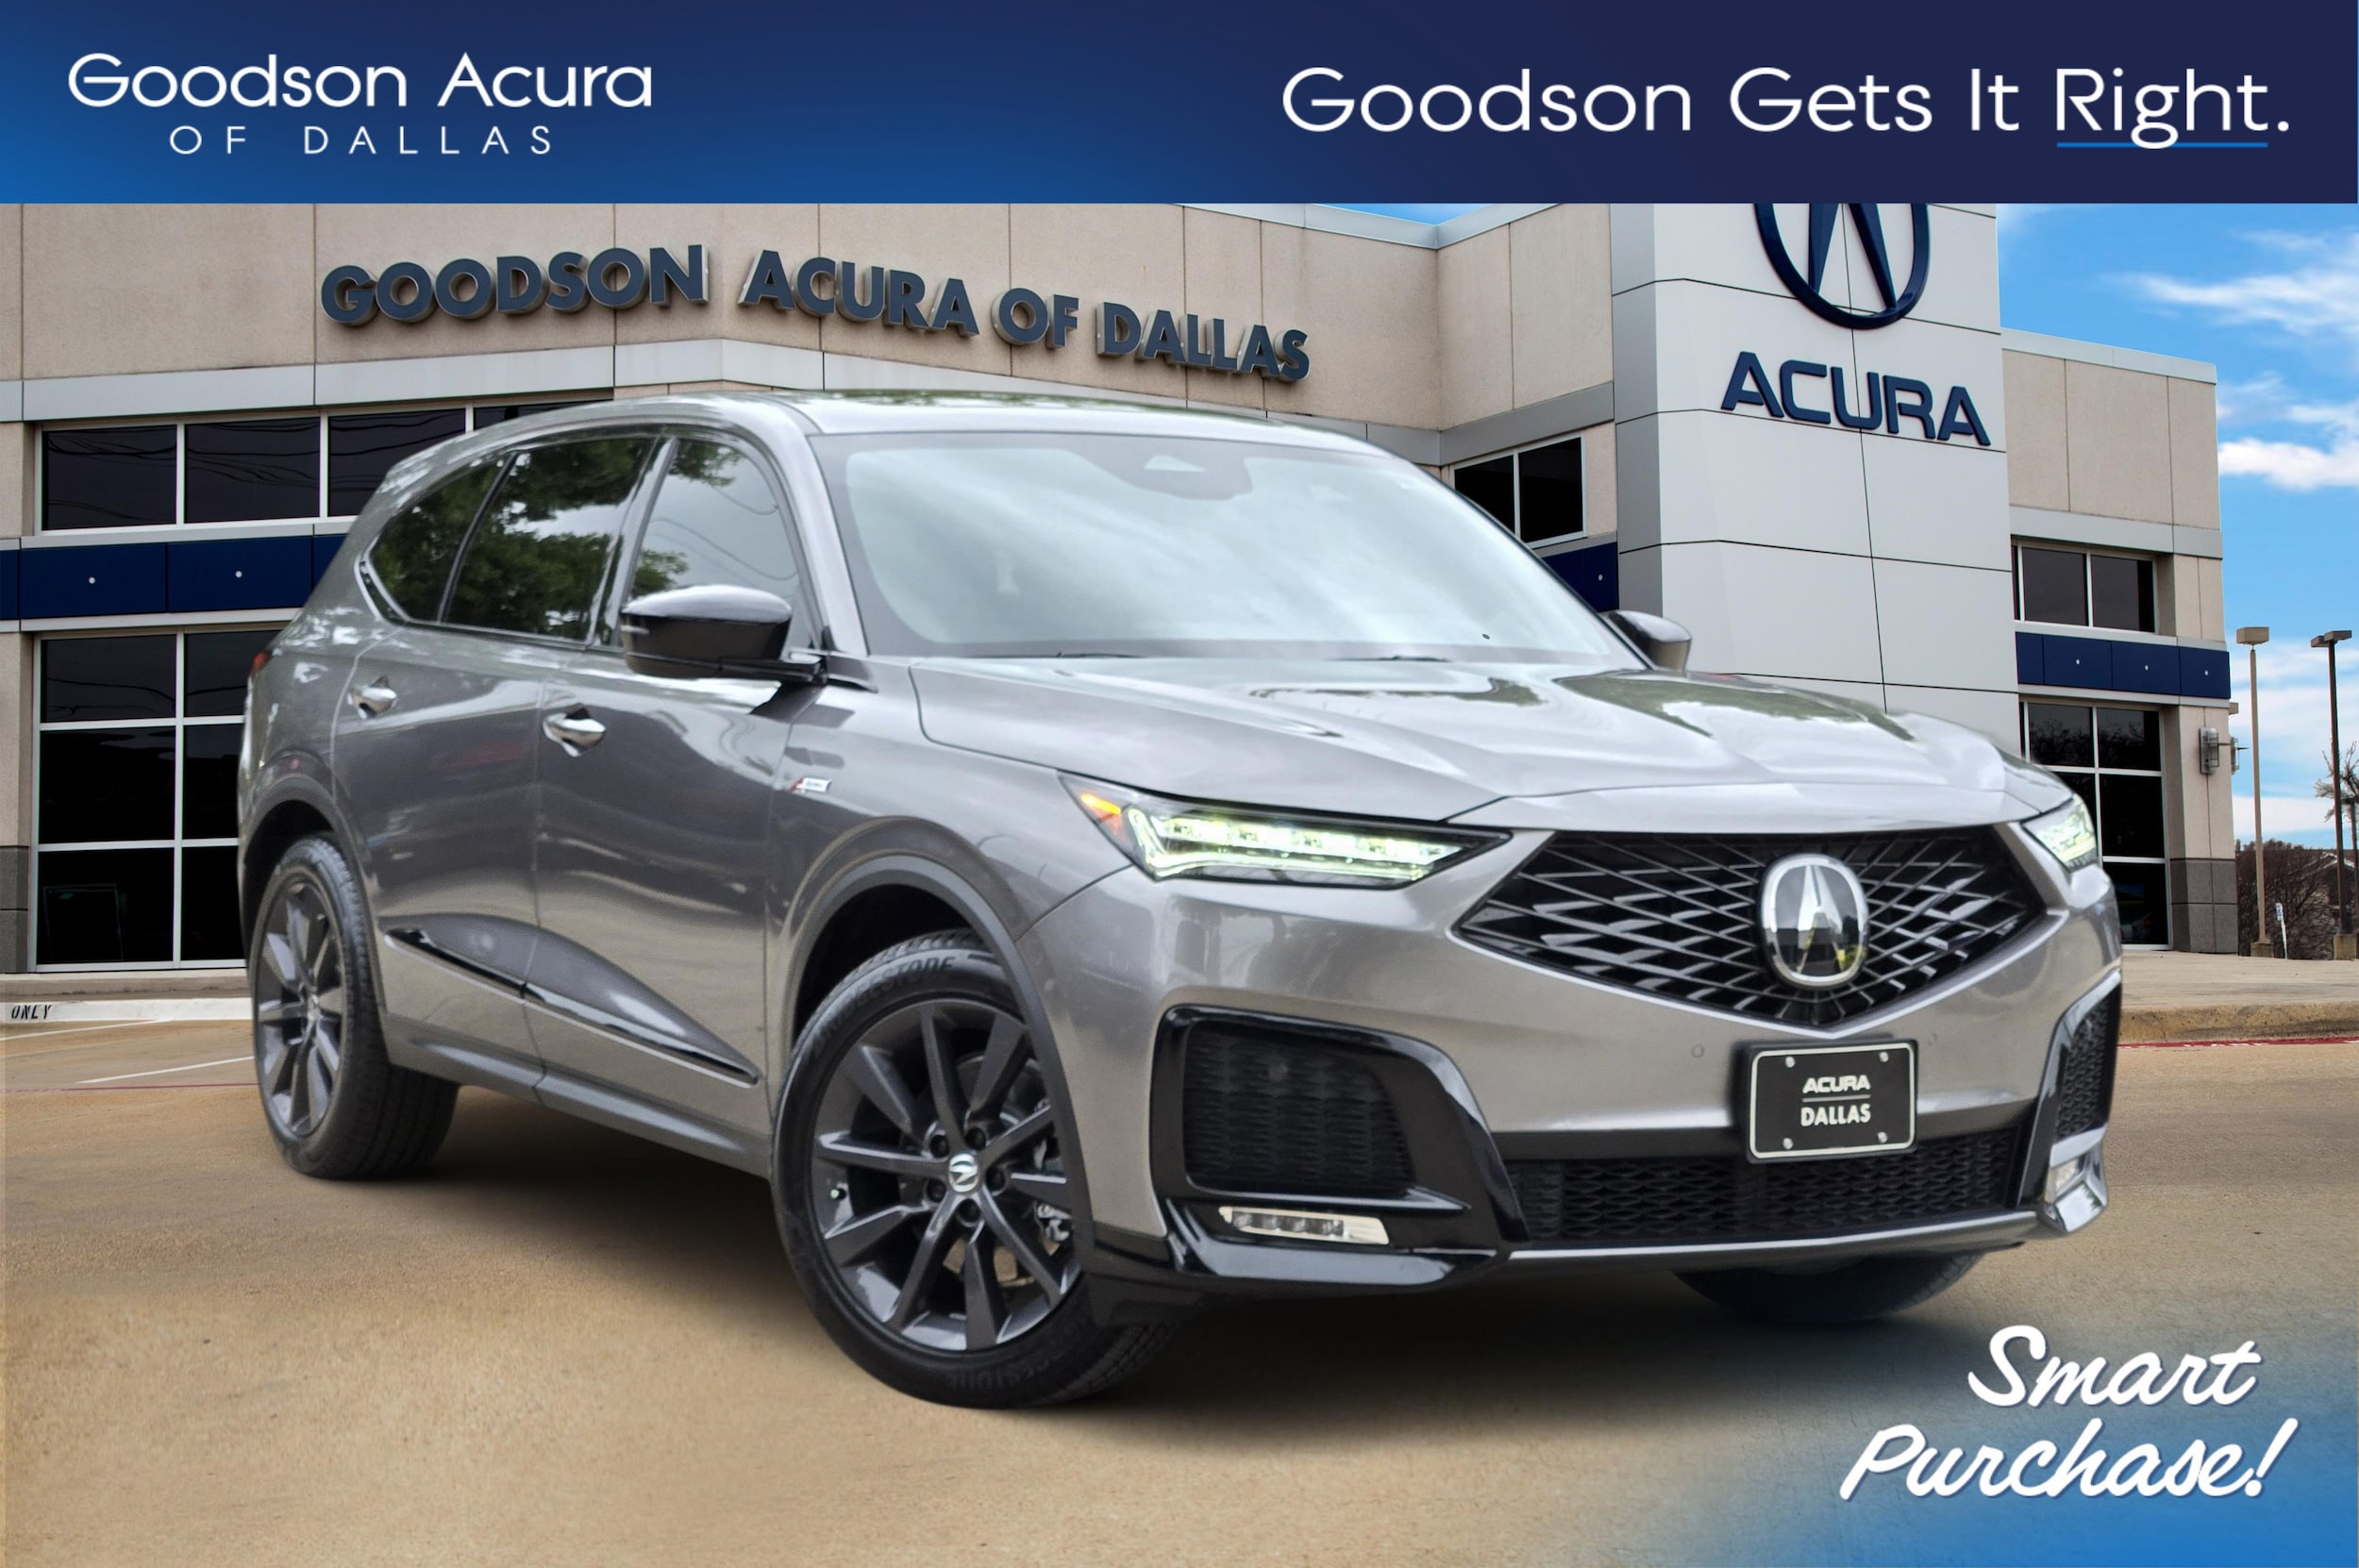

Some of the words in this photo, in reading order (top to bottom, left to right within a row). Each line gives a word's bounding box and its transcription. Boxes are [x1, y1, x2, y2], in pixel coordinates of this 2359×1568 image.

[322, 244, 708, 325] GOODSON
[740, 250, 979, 336] ACURA
[993, 289, 1079, 348] OF
[1097, 302, 1311, 380] DALLAS
[1720, 351, 1991, 447] ACURA
[10, 1004, 52, 1020] ONLY
[1802, 1075, 1871, 1093] ACURA
[1800, 1103, 1871, 1127] DALLAS
